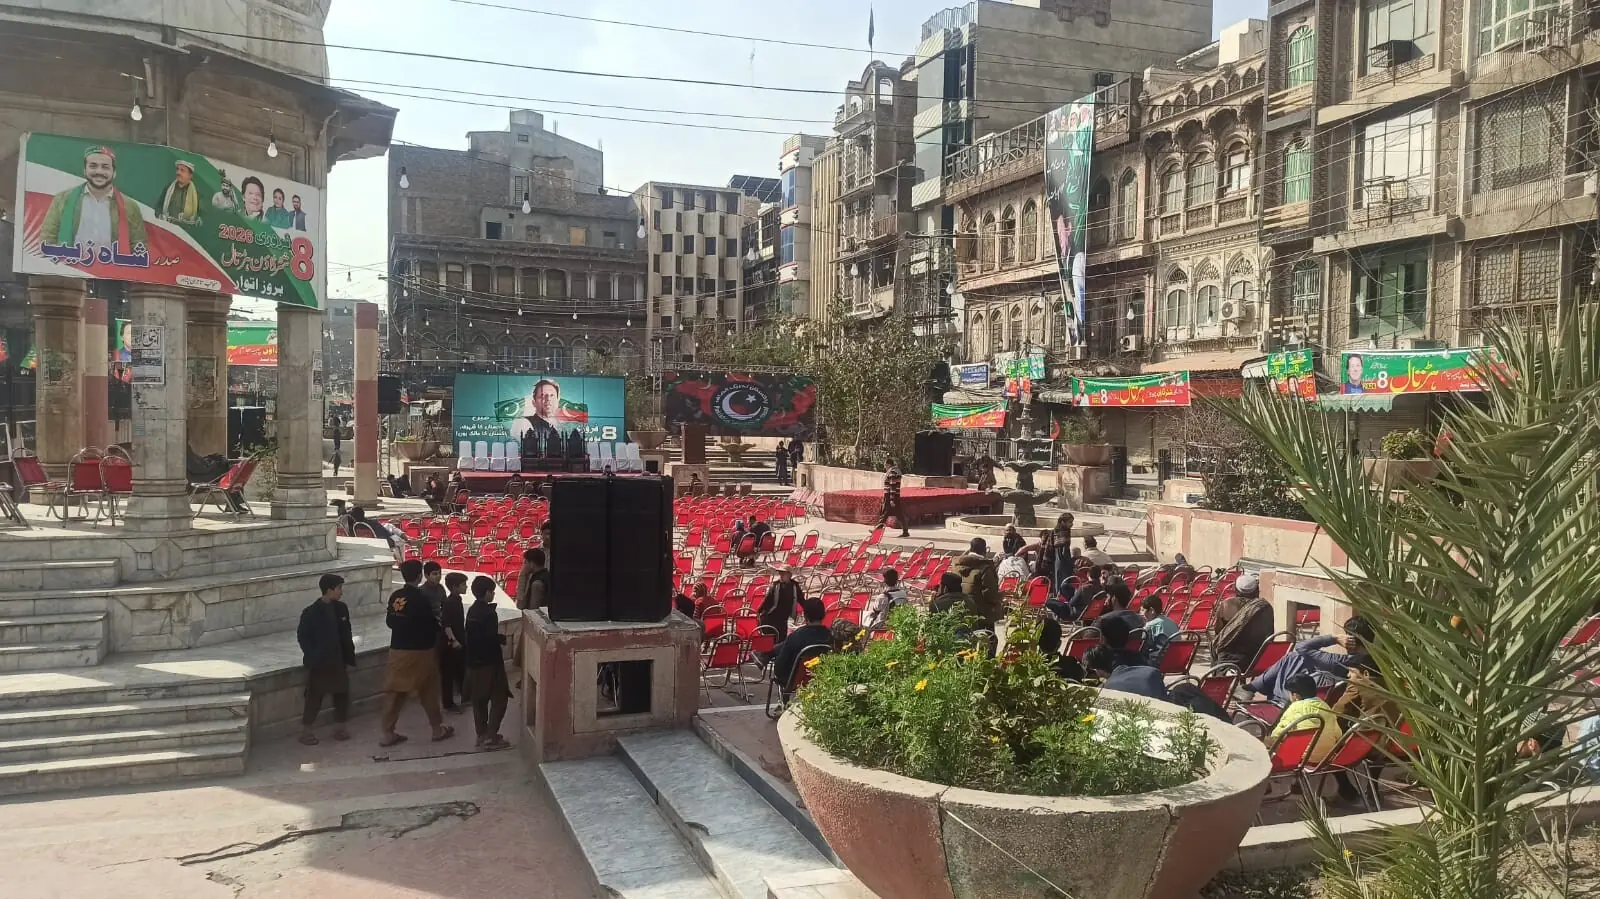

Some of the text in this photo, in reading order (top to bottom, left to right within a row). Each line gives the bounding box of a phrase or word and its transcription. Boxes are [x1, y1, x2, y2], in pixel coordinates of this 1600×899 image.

[39, 238, 181, 268] صدر شاہ زیب
[218, 223, 314, 281] 8 فروری 2026
[232, 275, 284, 296] بروز اتوار
[1377, 370, 1389, 389] 8
[1389, 359, 1440, 394] ہڑتال
[1101, 388, 1108, 404] 8
[1119, 378, 1146, 405] ہڑتال
[602, 425, 617, 440] 8
